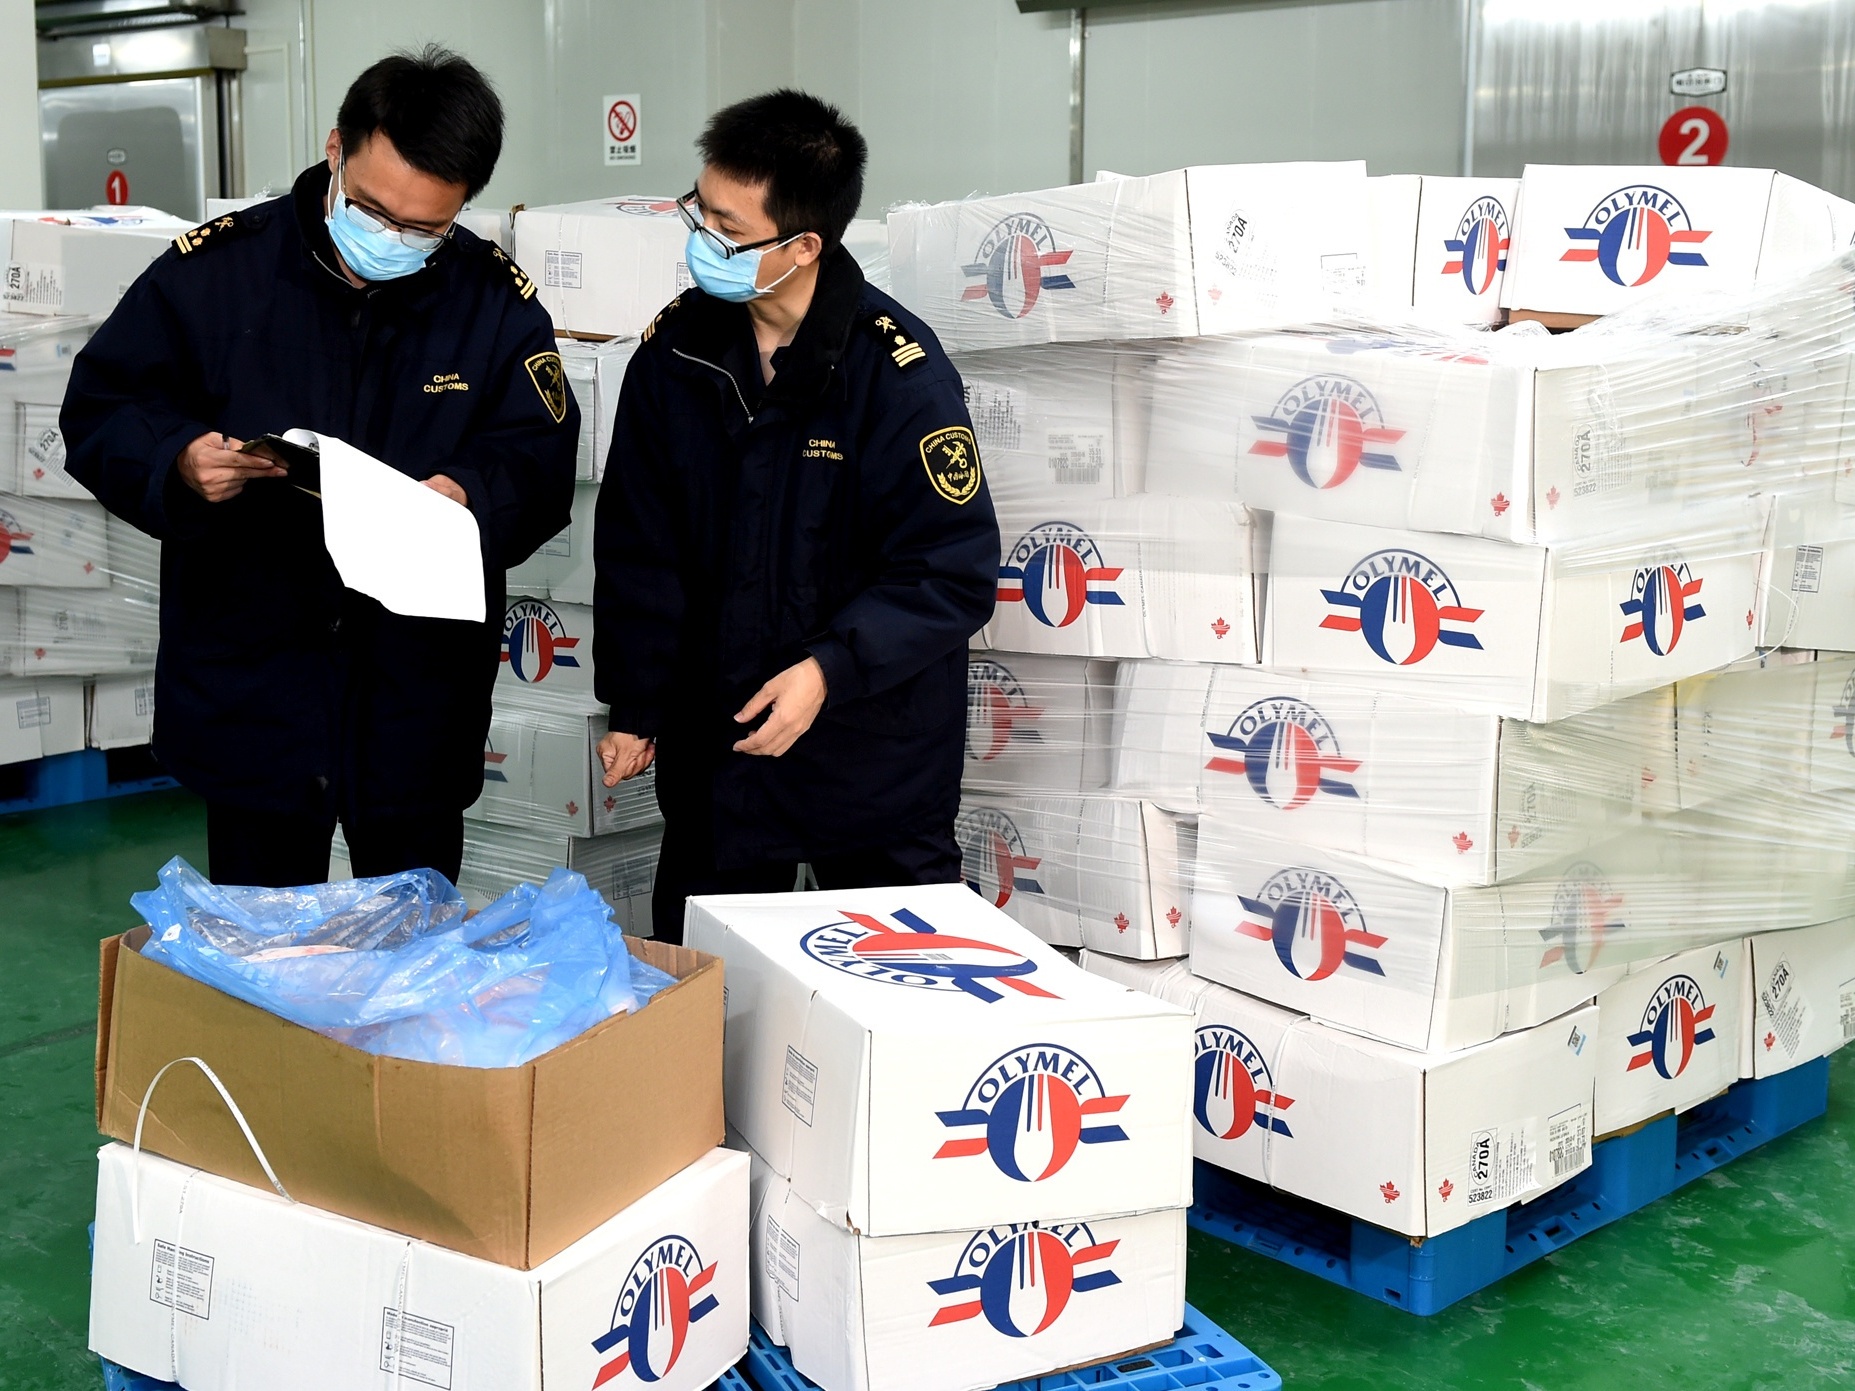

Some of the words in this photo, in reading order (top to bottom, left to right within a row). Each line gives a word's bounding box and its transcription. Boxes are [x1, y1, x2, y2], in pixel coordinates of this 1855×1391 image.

[1677, 118, 1710, 165] 2
[111, 176, 121, 204] 1
[1461, 201, 1505, 237] OLYMEL
[1594, 190, 1681, 228] OLYMEL
[982, 218, 1048, 259] OLYMEL
[1228, 216, 1248, 253] 270A
[10, 266, 21, 289] 270A
[423, 382, 469, 393] CUSTOMS
[433, 373, 460, 383] CHINA
[1283, 380, 1375, 424] OLYMEL
[40, 430, 58, 451] 270A
[802, 450, 844, 460] CUSTOMS
[809, 439, 836, 448] CHINA
[925, 435, 946, 454] CHINA
[945, 432, 972, 445] CUSTOMS
[1580, 430, 1591, 473] 270A
[1573, 482, 1597, 497] 523822
[1016, 527, 1093, 565] OLYMEL
[1353, 556, 1448, 601] OLYMEL
[504, 603, 558, 636] OLYMEL
[1239, 703, 1330, 751] OLYMEL
[1267, 873, 1354, 924] OLYMEL
[814, 927, 938, 986] OLYMEL
[1772, 968, 1790, 999] 270A
[1647, 981, 1699, 1025] OLYMEL
[978, 1051, 1090, 1103] OLYMEL
[1472, 1142, 1480, 1178] CANADA
[1477, 1138, 1490, 1180] 270A
[1469, 1189, 1493, 1204] 523822
[185, 1251, 210, 1264] Instructions
[620, 1243, 694, 1317] OLYMEL
